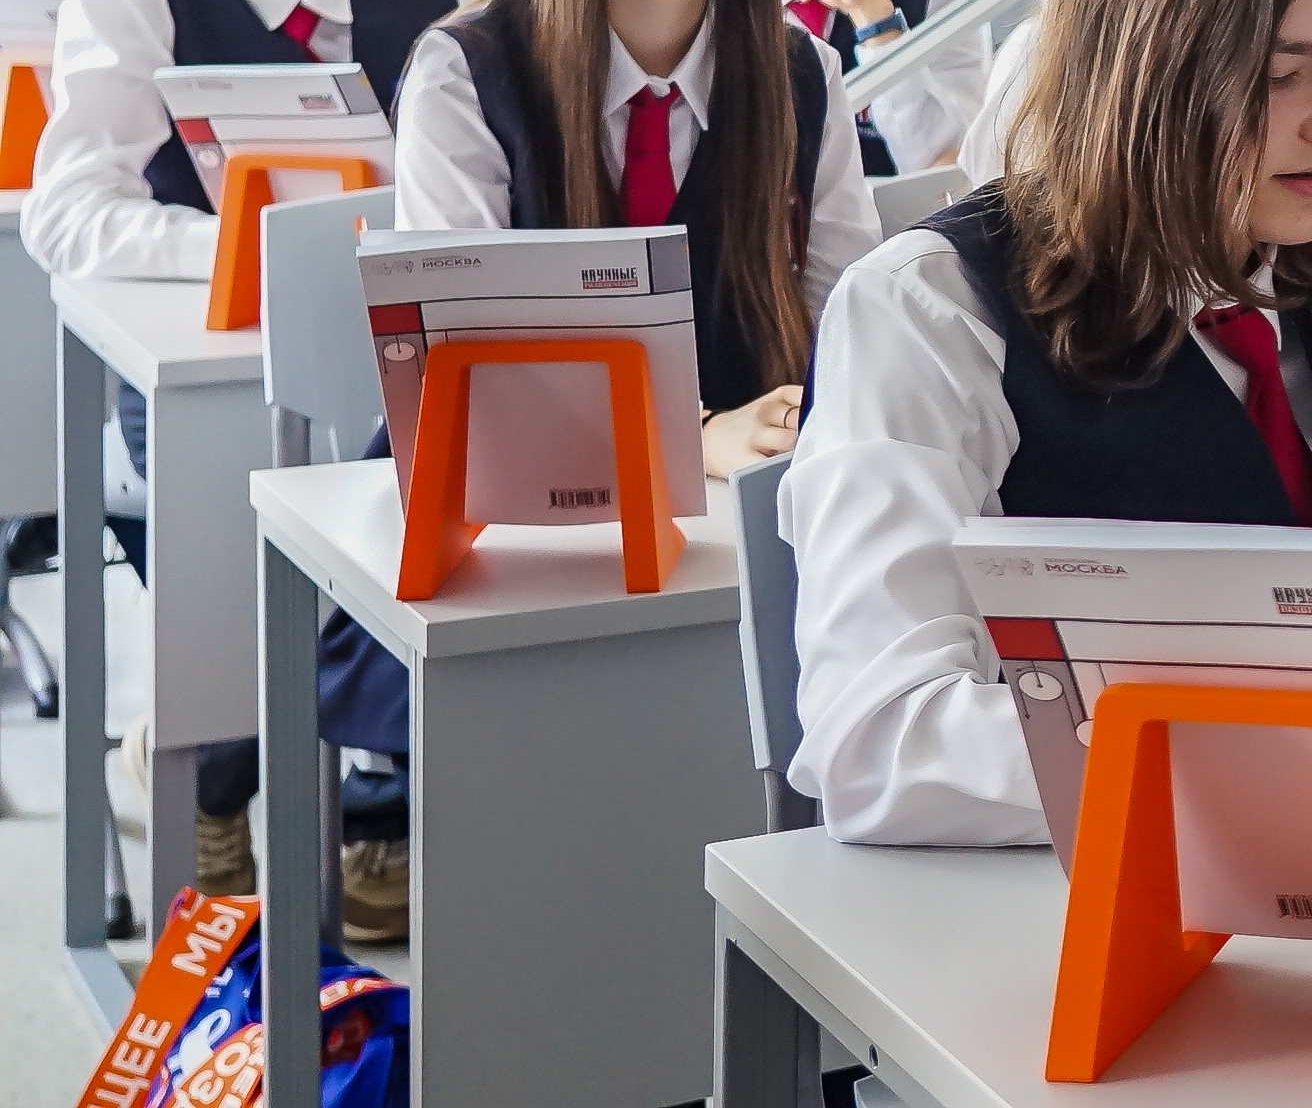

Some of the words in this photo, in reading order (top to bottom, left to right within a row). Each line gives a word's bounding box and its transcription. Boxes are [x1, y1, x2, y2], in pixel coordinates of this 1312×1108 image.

[422, 257, 482, 269] МОСКВА
[1044, 563, 1128, 574] МОСКВА
[171, 902, 246, 977] МЫ
